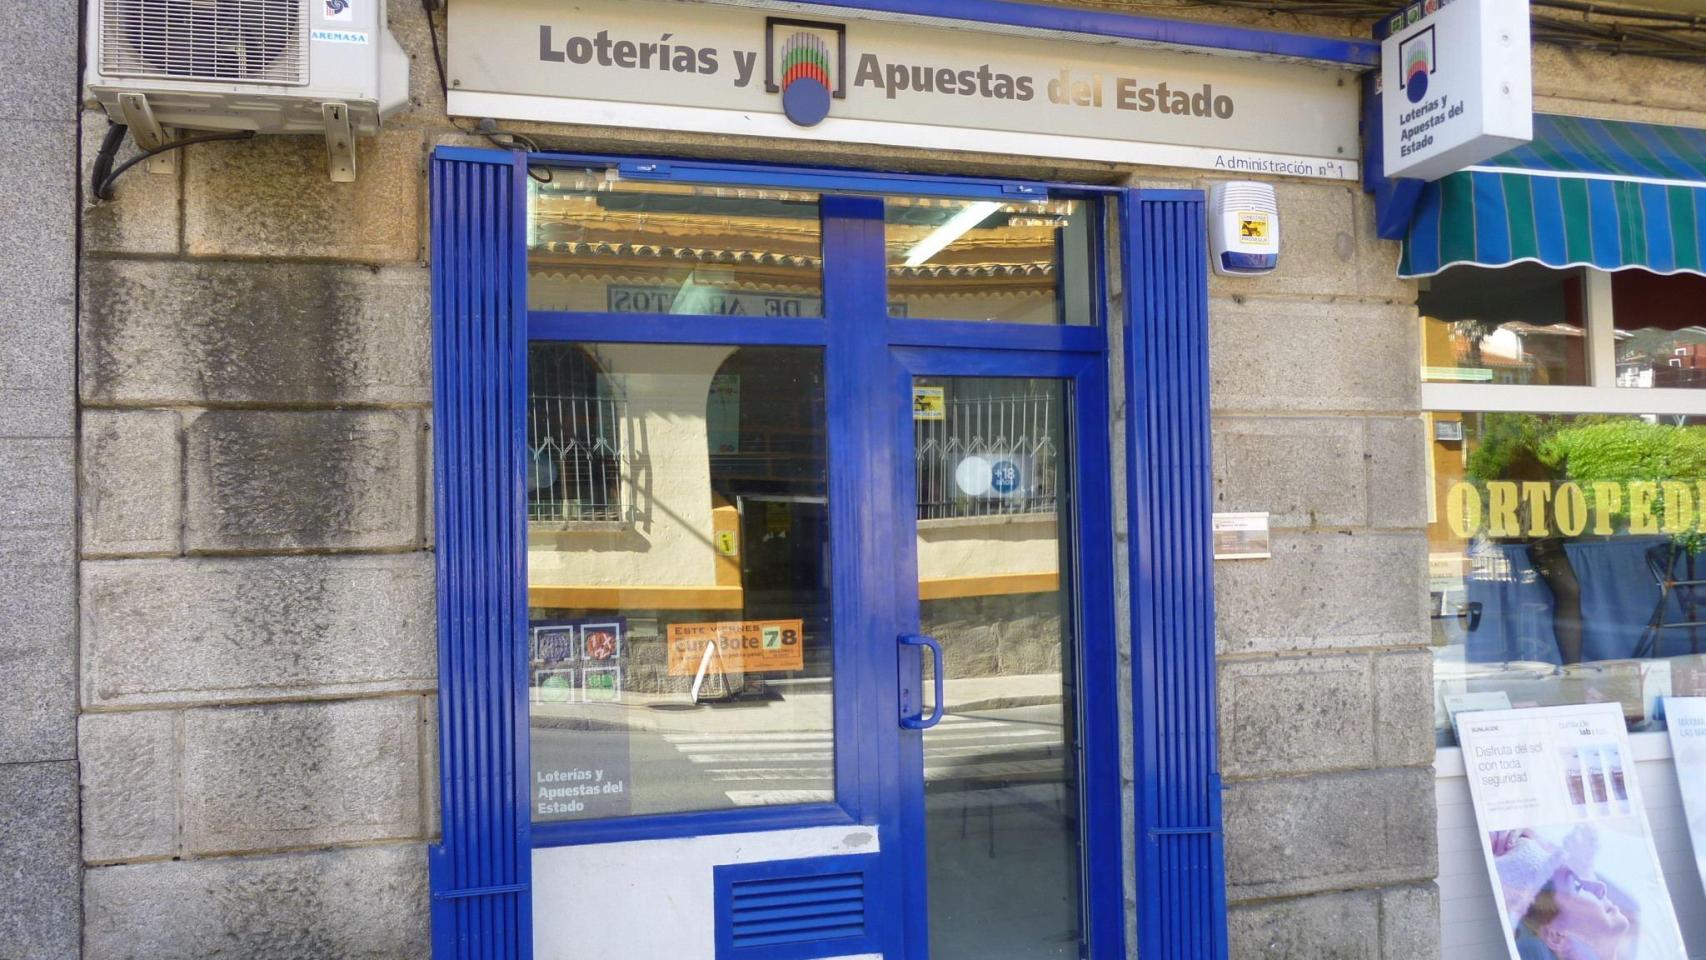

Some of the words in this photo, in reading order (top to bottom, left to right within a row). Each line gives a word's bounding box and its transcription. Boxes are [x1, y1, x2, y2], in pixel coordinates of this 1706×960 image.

[539, 25, 719, 75] Loterías
[733, 50, 757, 87] y
[854, 53, 1034, 102] Apuestas
[1047, 69, 1103, 107] del
[1116, 77, 1234, 120] Estado
[1400, 99, 1439, 126] Loterías
[1441, 94, 1448, 109] y
[1401, 112, 1446, 142] Apuestas
[1448, 100, 1464, 119] del
[1401, 134, 1434, 157] Estado
[1215, 154, 1313, 176] Administración
[537, 768, 592, 783] Loterías
[595, 769, 604, 782] y
[1478, 760, 1498, 772] con
[1481, 772, 1528, 787] seguridad
[539, 784, 600, 801] Apuestas
[602, 780, 623, 794] del
[537, 800, 584, 814] Estado
